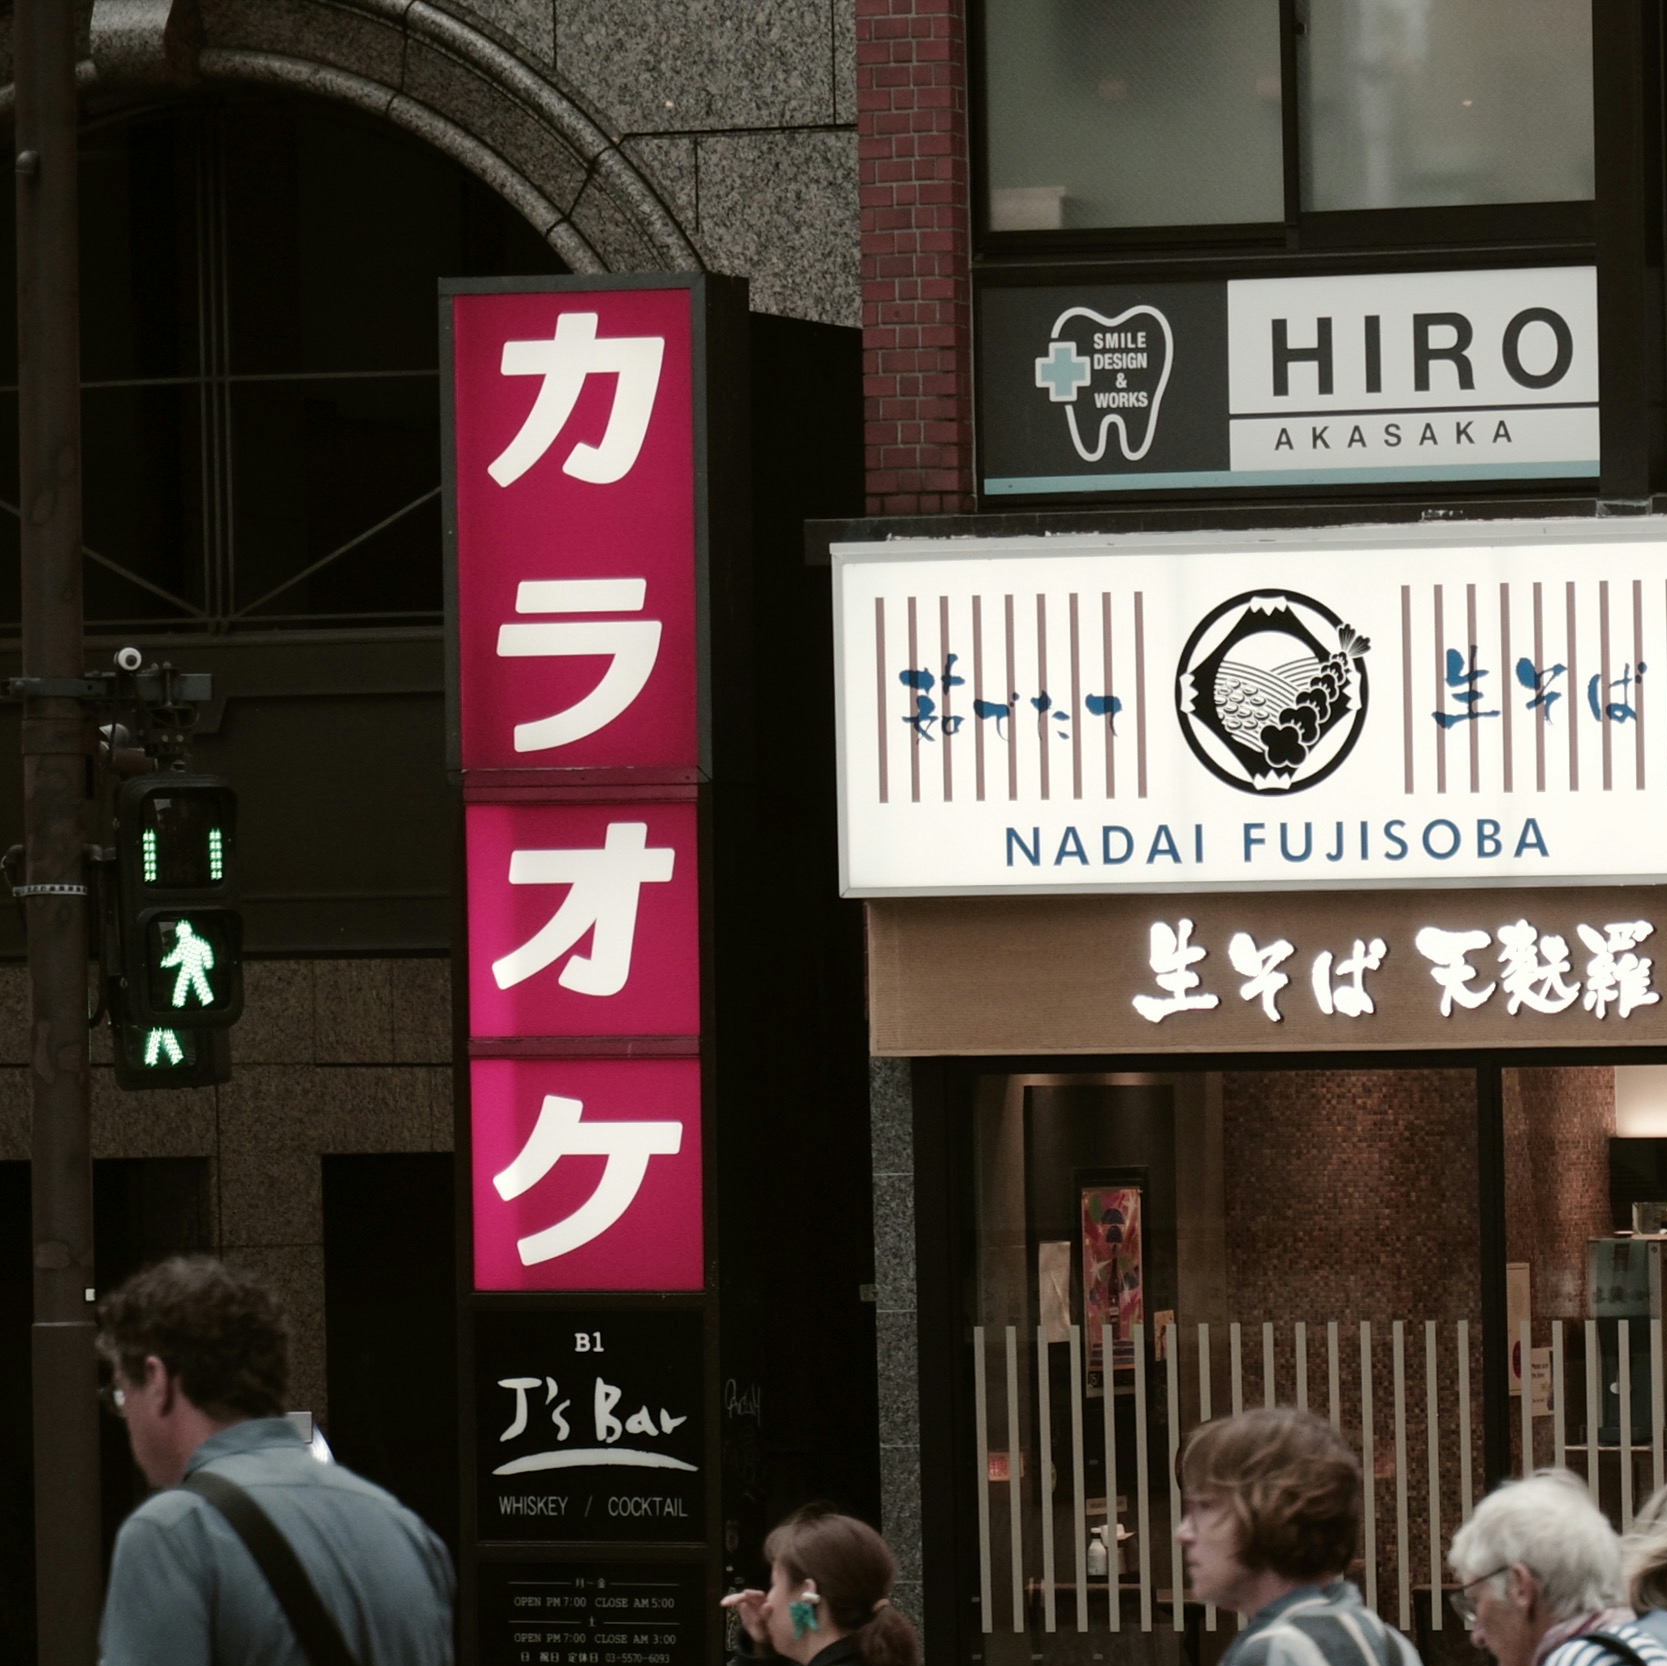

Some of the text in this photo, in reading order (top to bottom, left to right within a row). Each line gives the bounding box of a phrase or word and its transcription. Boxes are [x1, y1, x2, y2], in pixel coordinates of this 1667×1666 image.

[1093, 331, 1147, 351] SMILE
[1271, 306, 1573, 398] HIRO
[1093, 352, 1148, 371] DESIGN
[1116, 373, 1128, 389] &
[1094, 391, 1148, 409] WORKS
[1274, 420, 1514, 452] AKASAKA
[899, 652, 1122, 745] 茹でたて
[1434, 644, 1647, 729] 生そば
[488, 312, 683, 1266] カラオケ
[1005, 817, 1549, 867] NADAI FUJISOBA
[1132, 917, 1385, 1023] 生そば
[575, 1332, 604, 1352] B1
[497, 1376, 570, 1442] J's
[594, 1376, 688, 1443] Bar
[499, 1496, 569, 1517] WHISKEY
[608, 1496, 688, 1518] COCKTAIL
[514, 1597, 541, 1607] OPEN
[595, 1597, 628, 1608] CLOSE
[514, 1633, 541, 1643] OPEN
[594, 1633, 628, 1644] CLOSE
